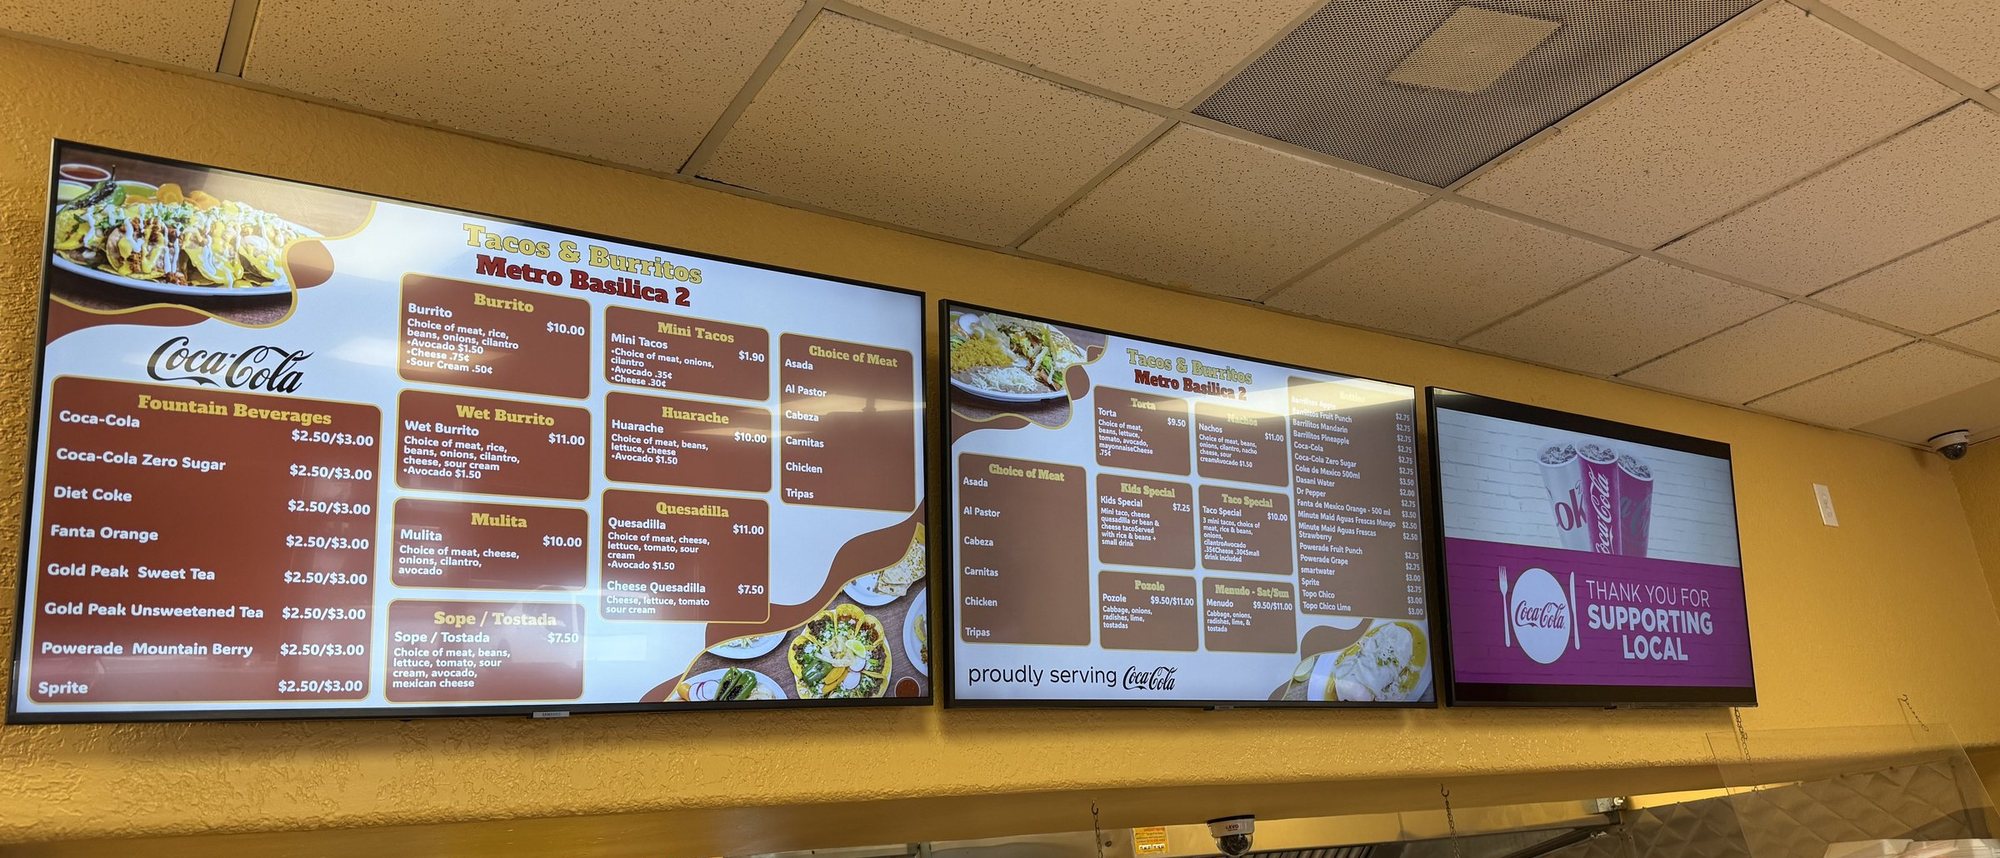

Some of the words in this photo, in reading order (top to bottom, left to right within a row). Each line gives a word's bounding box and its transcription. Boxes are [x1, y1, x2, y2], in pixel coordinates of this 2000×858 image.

[463, 223, 550, 258] Tacos
[558, 240, 581, 263] &
[589, 245, 702, 284] Burritos
[476, 254, 562, 286] Metro
[570, 270, 668, 304] Basilica
[676, 287, 690, 307] 2
[474, 293, 534, 313] Burrito
[408, 303, 452, 318] Burrito
[408, 318, 441, 332] Choice
[444, 323, 455, 332] of
[458, 324, 486, 338] meat,
[488, 328, 508, 340] rice,
[546, 322, 584, 336] $10.00
[658, 321, 692, 337] Mini
[695, 327, 734, 343] Tacos
[407, 328, 440, 341] beans,
[443, 332, 479, 345] onions,
[482, 337, 518, 350] cilantro
[611, 333, 635, 344] Mini
[639, 337, 668, 349] Tacos
[738, 350, 764, 362] $1.90
[809, 345, 849, 360] Choice
[853, 353, 864, 362] of
[867, 354, 898, 368] Meat
[785, 358, 813, 370] Asada
[1127, 348, 1172, 371] Tacos
[1176, 358, 1188, 373] &
[1192, 360, 1252, 384] Burritos
[785, 384, 795, 393] Al
[798, 386, 827, 397] Pastor
[1134, 369, 1179, 390] Metro
[1183, 377, 1235, 400] Basilica
[1238, 387, 1247, 401] 2
[138, 395, 227, 416] Fountain
[234, 403, 332, 426] Beverages
[1131, 398, 1156, 410] Torta
[456, 405, 490, 420] Wet
[495, 408, 554, 426] Burrito
[662, 406, 729, 424] Huarache
[785, 410, 819, 422] Cabeza
[1098, 407, 1116, 417] Torta
[59, 411, 140, 428] Coca-Cola
[612, 419, 664, 433] Huarache
[1168, 417, 1186, 427] $9.50
[1228, 413, 1257, 426] Nachos
[405, 420, 431, 432] Wet
[435, 423, 479, 437] Burrito
[1199, 424, 1223, 433] Nachos
[292, 429, 373, 446] $2.50/$3.00
[548, 433, 585, 446] $11.00
[734, 432, 767, 443] $10.00
[786, 436, 824, 448] Carnitas
[1265, 432, 1284, 442] $11.00
[1294, 441, 1323, 452] Coca-Cola
[56, 448, 138, 465] Coca-Cola
[142, 454, 177, 468] Zero
[182, 456, 225, 473] Sugar
[786, 462, 822, 473] Chicken
[290, 464, 372, 481] $2.50/$3.00
[989, 463, 1024, 477] Choice
[1026, 469, 1037, 479] of
[1038, 469, 1064, 482] Meat
[963, 477, 988, 488] Asada
[54, 486, 88, 500] Diet
[92, 488, 132, 502] Coke
[786, 488, 814, 499] Tripas
[1121, 483, 1141, 495] Kids
[1143, 485, 1175, 498] Special
[288, 500, 370, 515] $2.50/$3.00
[1101, 496, 1116, 505] Kids
[1117, 497, 1142, 508] Special
[1173, 503, 1190, 512] $7.25
[1221, 494, 1242, 505] Taco
[1244, 496, 1272, 508] Special
[656, 502, 729, 518] Quesadilla
[964, 506, 973, 515] Al
[975, 507, 1000, 518] Pastor
[1203, 506, 1217, 515] Taco
[1219, 507, 1242, 518] Special
[1267, 512, 1287, 522] $10.00
[471, 512, 528, 528] Mulita
[608, 517, 666, 530] Quesadilla
[51, 525, 95, 539] Fanta
[100, 527, 159, 543] Orange
[401, 529, 442, 541] Mulita
[733, 525, 764, 535] $11.00
[286, 535, 369, 550] $2.50/$3.00
[543, 535, 582, 547] $10.00
[964, 536, 993, 547] Cabeza
[400, 545, 435, 555] Choice
[437, 546, 449, 555] of
[451, 547, 480, 558] meat,
[483, 548, 520, 559] cheese,
[399, 556, 437, 566] onions,
[440, 556, 482, 568] cilantro,
[47, 564, 85, 577] Gold
[91, 565, 129, 578] Peak
[138, 567, 186, 580] Sweet
[190, 568, 215, 580] Tea
[399, 567, 442, 575] avocado
[964, 566, 999, 577] Carnitas
[1301, 567, 1335, 575] smartwater
[284, 571, 367, 586] $2.50/$3.00
[1302, 578, 1319, 587] Sprite
[607, 581, 646, 591] Cheese
[650, 582, 705, 594] Quesadilla
[738, 585, 764, 594] $7.50
[1135, 580, 1165, 592] Pozole
[1215, 584, 1249, 596] Menudo
[1257, 587, 1289, 599] Sat/Sun
[1103, 593, 1126, 603] Pozole
[1151, 595, 1194, 606] $9.50/$11.00
[1302, 590, 1317, 598] Topo
[1318, 591, 1335, 599] Chico
[1586, 580, 1641, 603] THANK
[1645, 585, 1676, 605] YOU
[1682, 589, 1710, 607] FOR
[965, 596, 997, 607] Chicken
[1207, 598, 1233, 608] Menudo
[1253, 601, 1292, 611] $9.50/$11.00
[44, 602, 83, 616] Gold
[88, 604, 126, 616] Peak
[131, 604, 235, 618] Unsweetened
[239, 606, 264, 619] Tea
[282, 606, 366, 621] $2.50/$3.00
[434, 611, 476, 627] Sope
[480, 611, 488, 627] /
[492, 612, 557, 626] Tostada
[1588, 604, 1713, 635] SUPPORTING
[394, 631, 427, 645] Sope
[431, 632, 437, 643] /
[441, 631, 489, 643] Tostada
[548, 632, 579, 644] $7.50
[965, 627, 990, 638] Tripas
[41, 642, 123, 655] Powerade
[132, 643, 207, 656] Mountain
[212, 643, 253, 659] Berry
[280, 643, 364, 657] $2.50/$3.00
[1623, 635, 1688, 660] LOCAL
[969, 664, 1043, 686] proudly
[1050, 666, 1116, 686] serving
[38, 681, 88, 697] Sprite
[278, 680, 363, 694] $2.50/$3.00
